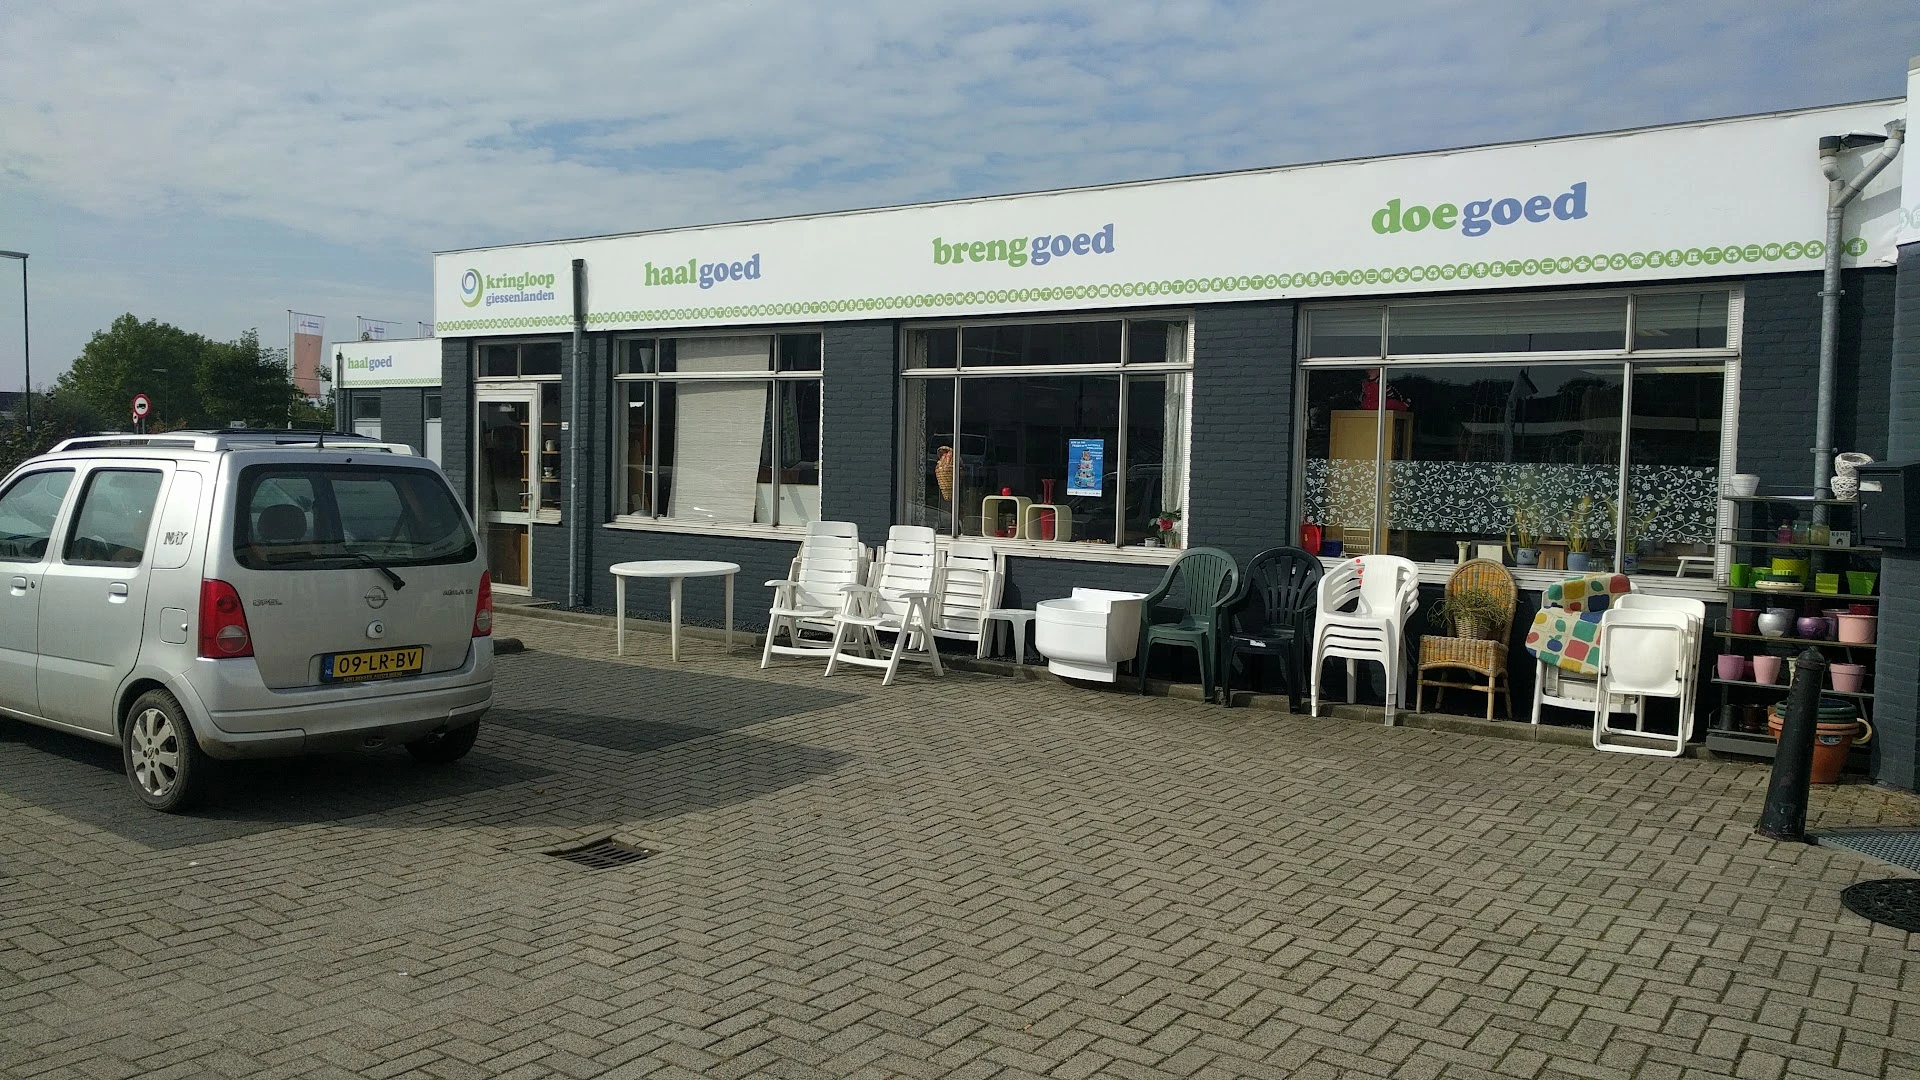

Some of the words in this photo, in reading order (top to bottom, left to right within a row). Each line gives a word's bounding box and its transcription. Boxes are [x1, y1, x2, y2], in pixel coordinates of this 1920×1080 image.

[486, 271, 555, 291] kringloop
[485, 289, 555, 306] giessenlanden
[252, 598, 283, 607] OPEL
[339, 651, 417, 673] 09-LR-BV
